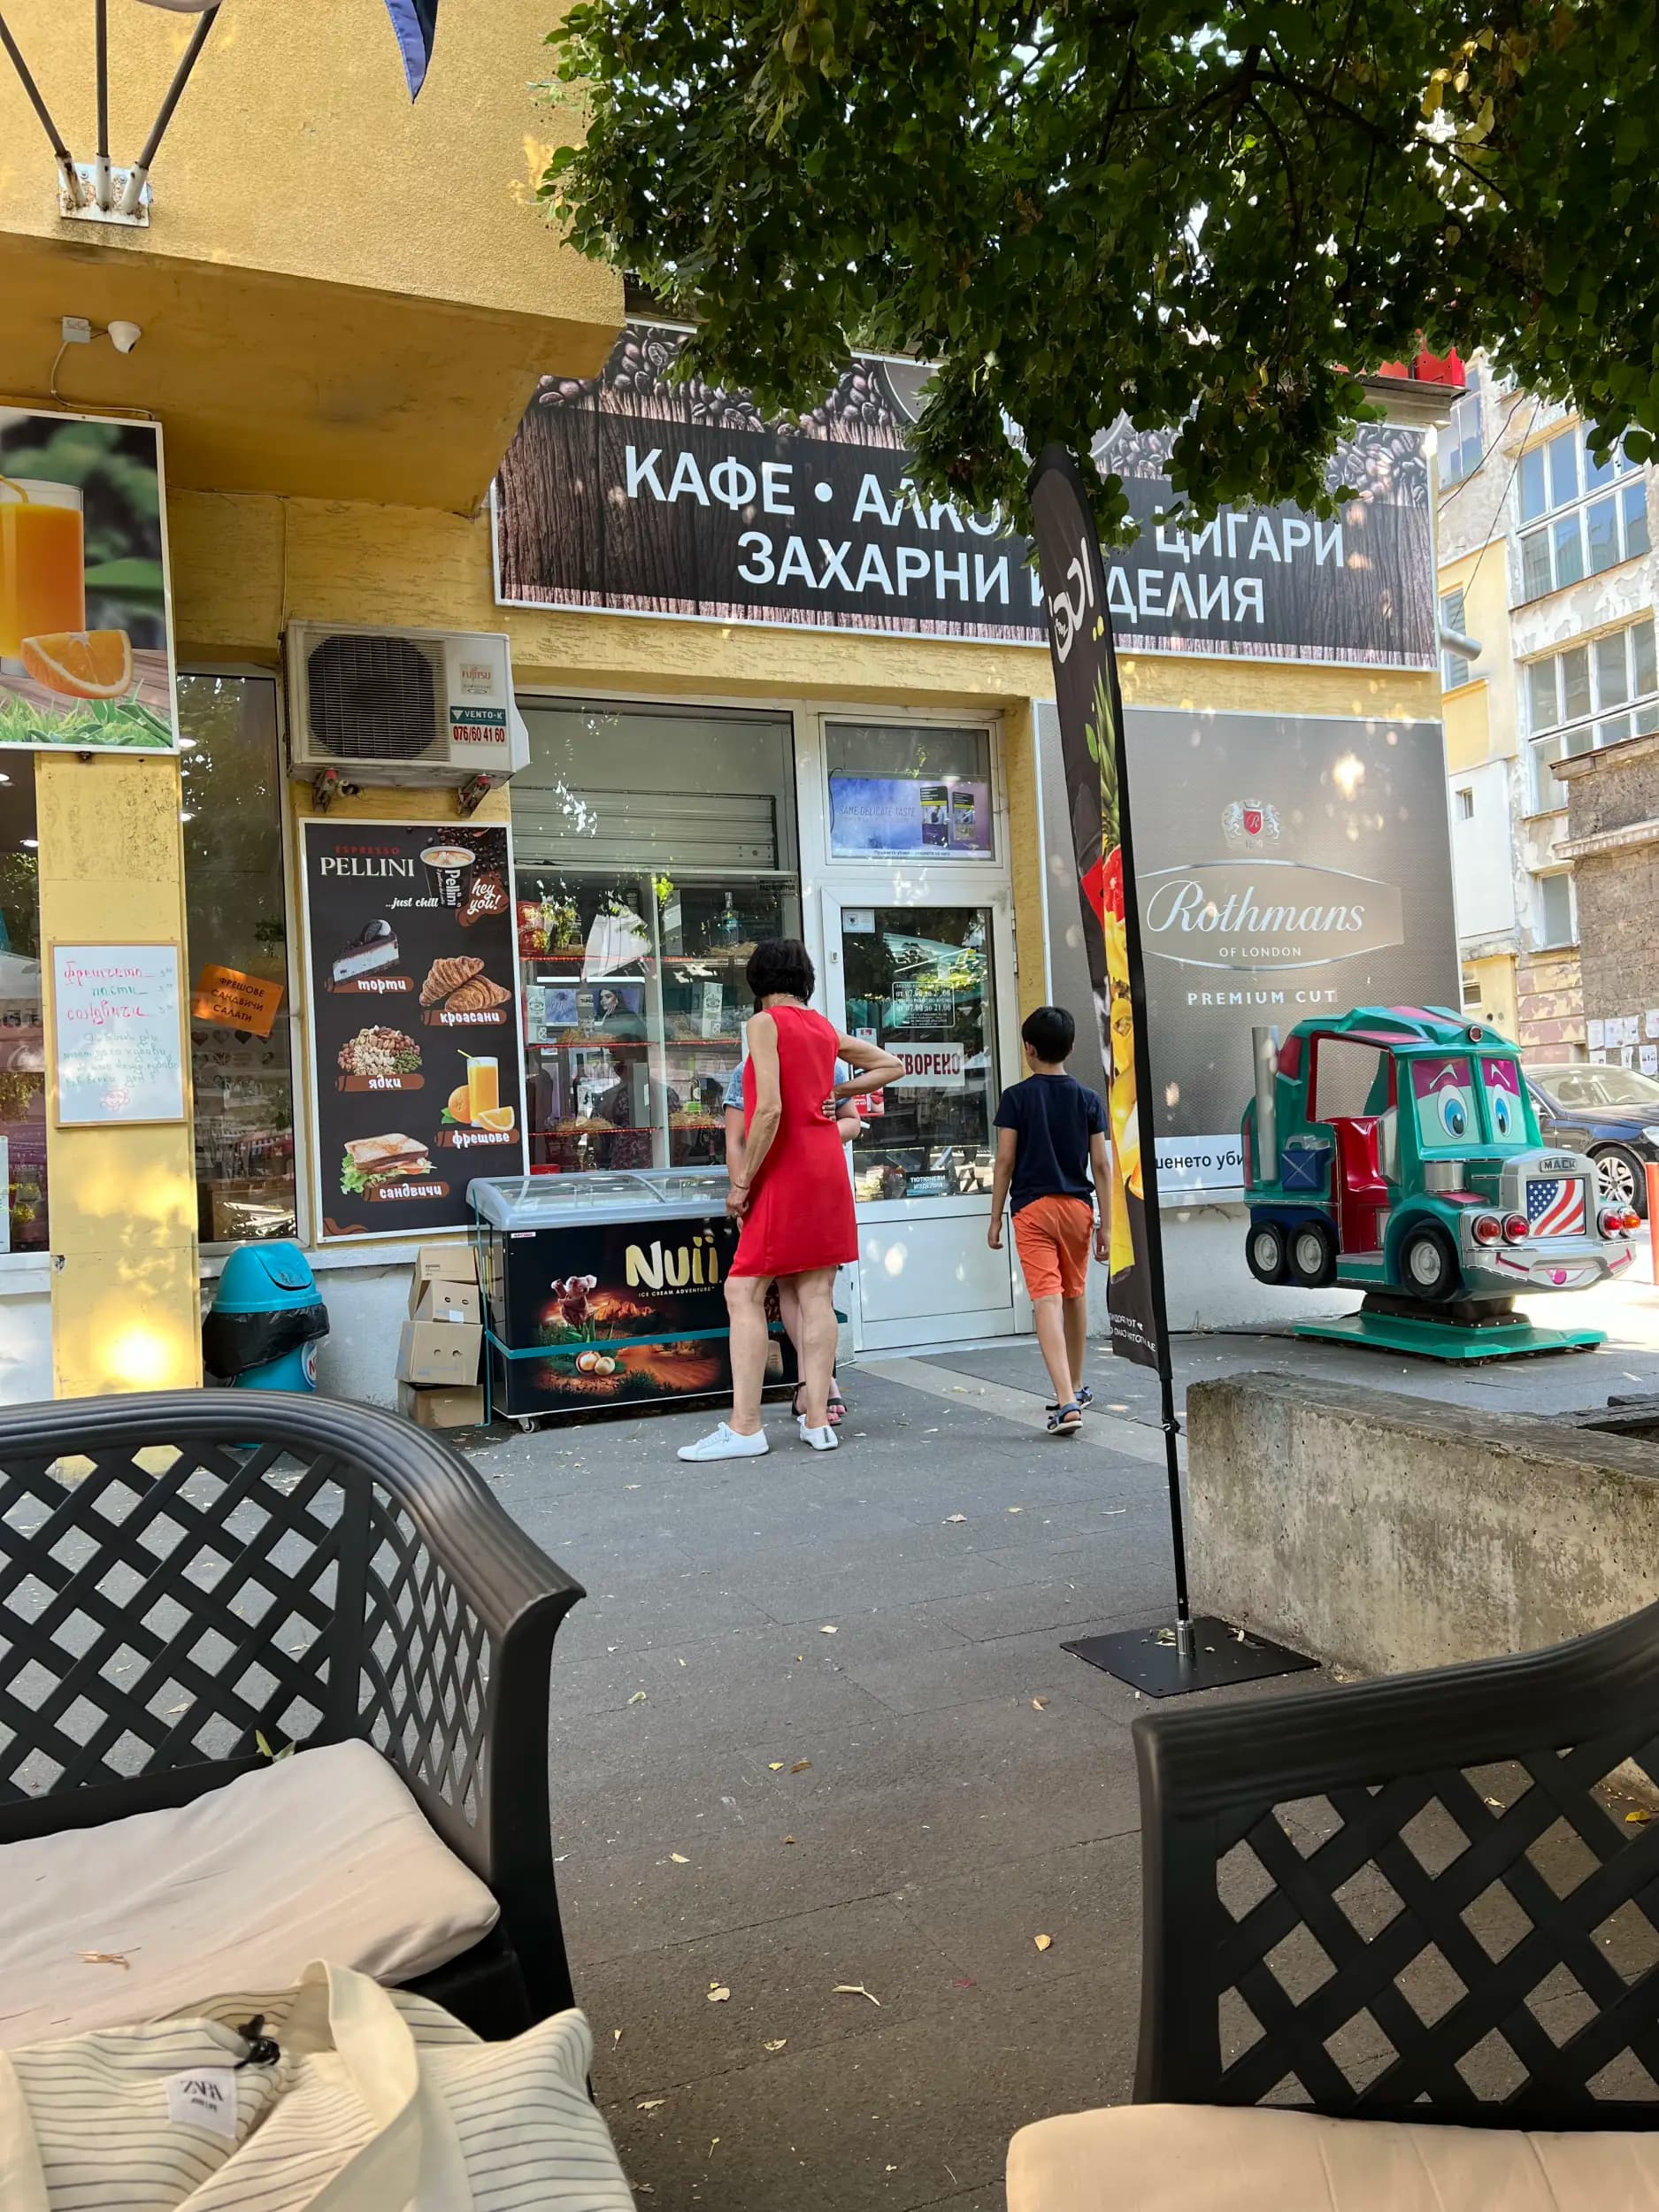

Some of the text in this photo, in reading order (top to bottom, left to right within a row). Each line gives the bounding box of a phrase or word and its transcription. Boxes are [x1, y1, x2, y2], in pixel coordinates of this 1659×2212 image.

[626, 445, 1344, 567] КАФЕ АЛКО ЦИГАРИ
[737, 531, 1010, 604] ЗАХАРНИ
[1030, 565, 1264, 624] ДЕЛИЯ
[462, 670, 491, 680] FUJITSU
[465, 710, 503, 719] VENTO-K
[453, 726, 505, 743] 076/60 41 60
[840, 805, 856, 815] SAME
[334, 845, 400, 856] ESPRESSO
[320, 856, 415, 877] PELLINI
[445, 869, 461, 907] Pellini
[472, 879, 495, 899] hey
[415, 897, 439, 908] chill
[466, 895, 502, 915] you!
[1147, 879, 1364, 932] Rothmans
[1219, 947, 1302, 957] OF LONDON
[219, 977, 265, 997] ФРЕШОВЕ
[357, 979, 407, 994] торти
[211, 988, 264, 1012] САНДВИЧИ
[1187, 990, 1335, 1006] PREMIUM CUT
[213, 1004, 252, 1023] САЛАТИ
[440, 1011, 500, 1026] кроасани
[892, 1053, 961, 1076] ВОРЕНО
[368, 1076, 402, 1089] ядки
[452, 1131, 511, 1148] фрешове
[1156, 1151, 1242, 1171] шенето уби
[1544, 1160, 1575, 1169] MACK
[380, 1186, 442, 1199] сандвичи
[626, 1235, 718, 1289] Nuii
